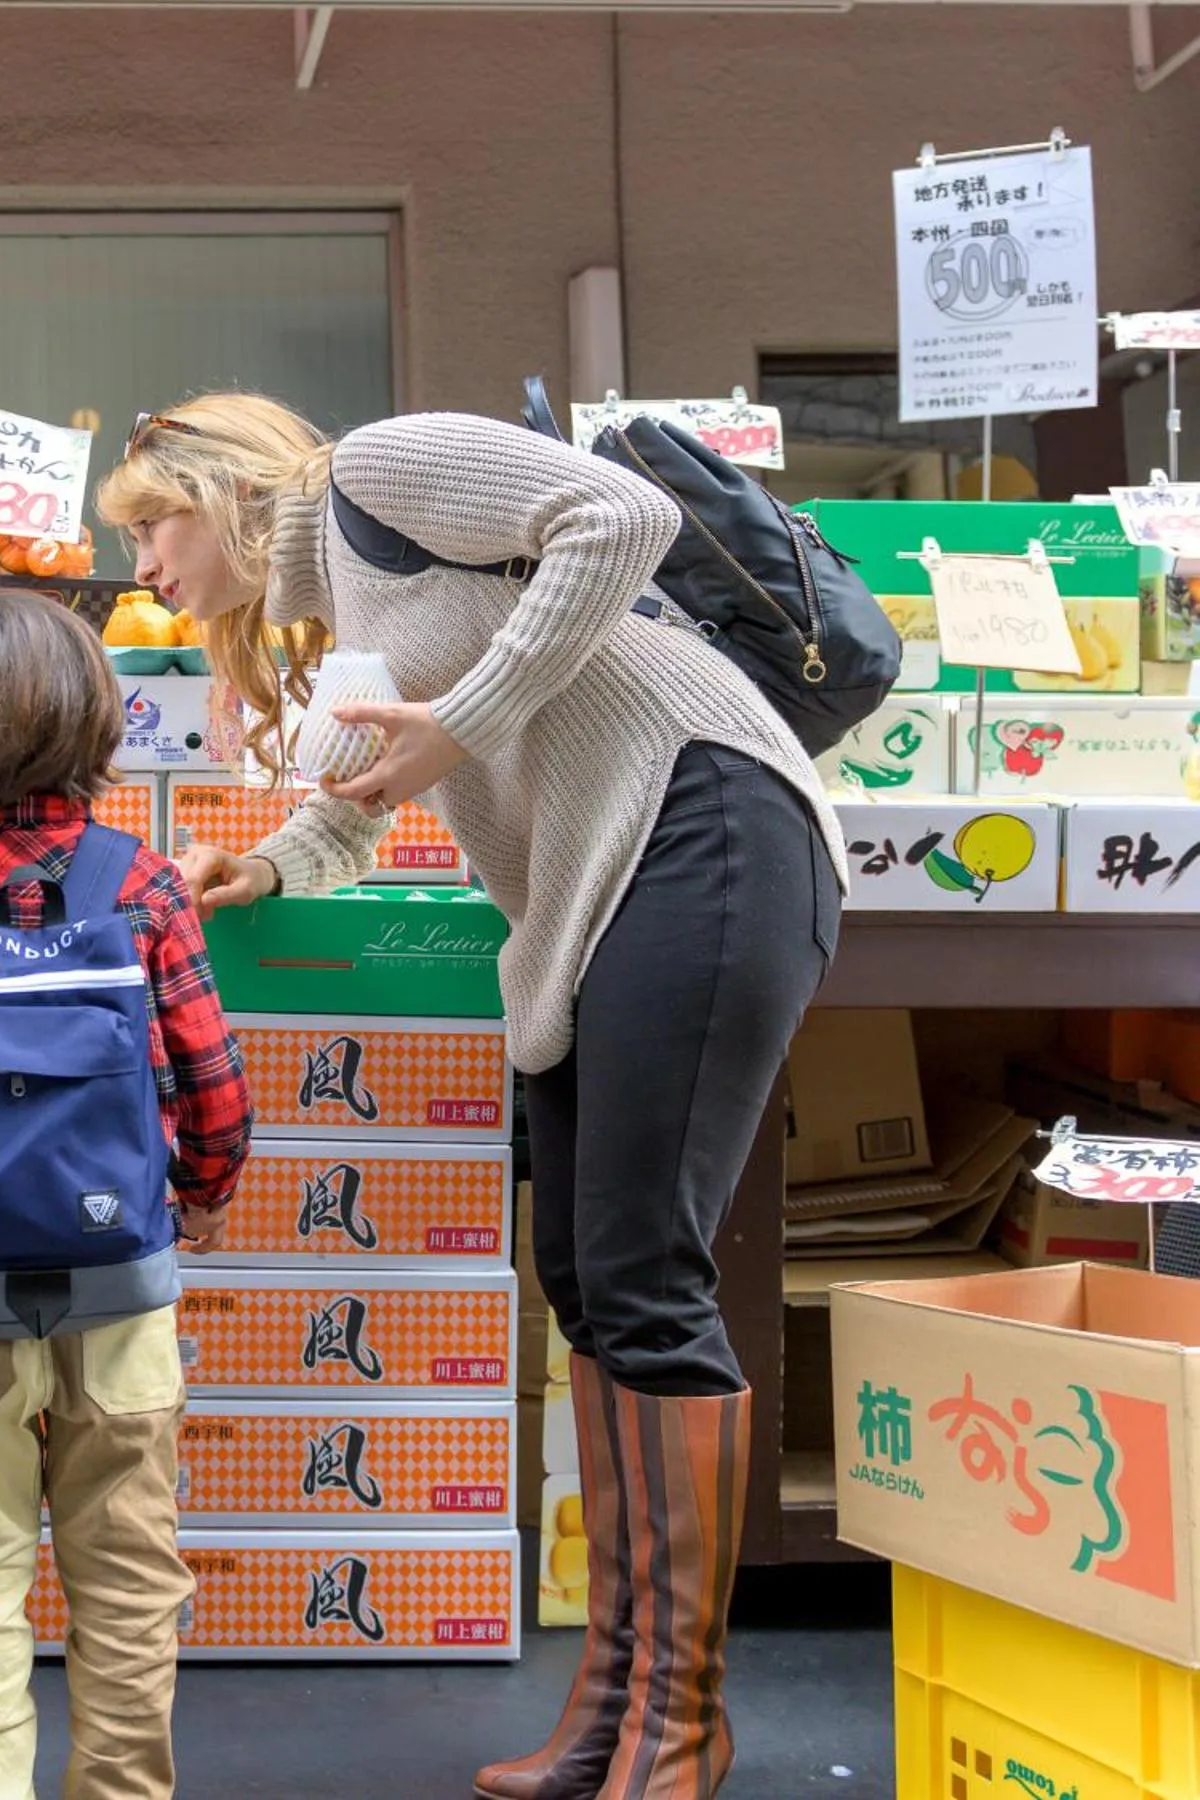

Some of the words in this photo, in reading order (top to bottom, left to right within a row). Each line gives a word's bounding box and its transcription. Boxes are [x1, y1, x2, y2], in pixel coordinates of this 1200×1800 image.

[914, 175, 988, 202] 地方発送
[120, 736, 173, 749] あまくさ
[395, 849, 456, 867] 川上蜜柑
[430, 1103, 497, 1122] 川上蜜柑
[429, 1230, 496, 1249] 川上蜜柑
[184, 1296, 235, 1312] 西宇和
[434, 1361, 502, 1380] 川上蜜柑
[184, 1424, 233, 1440] 西宇和
[857, 1380, 912, 1466] 柿
[849, 1463, 924, 1500] JAならけん
[434, 1489, 502, 1509] 川上蜜柑
[436, 1622, 504, 1640] 川上蜜柑
